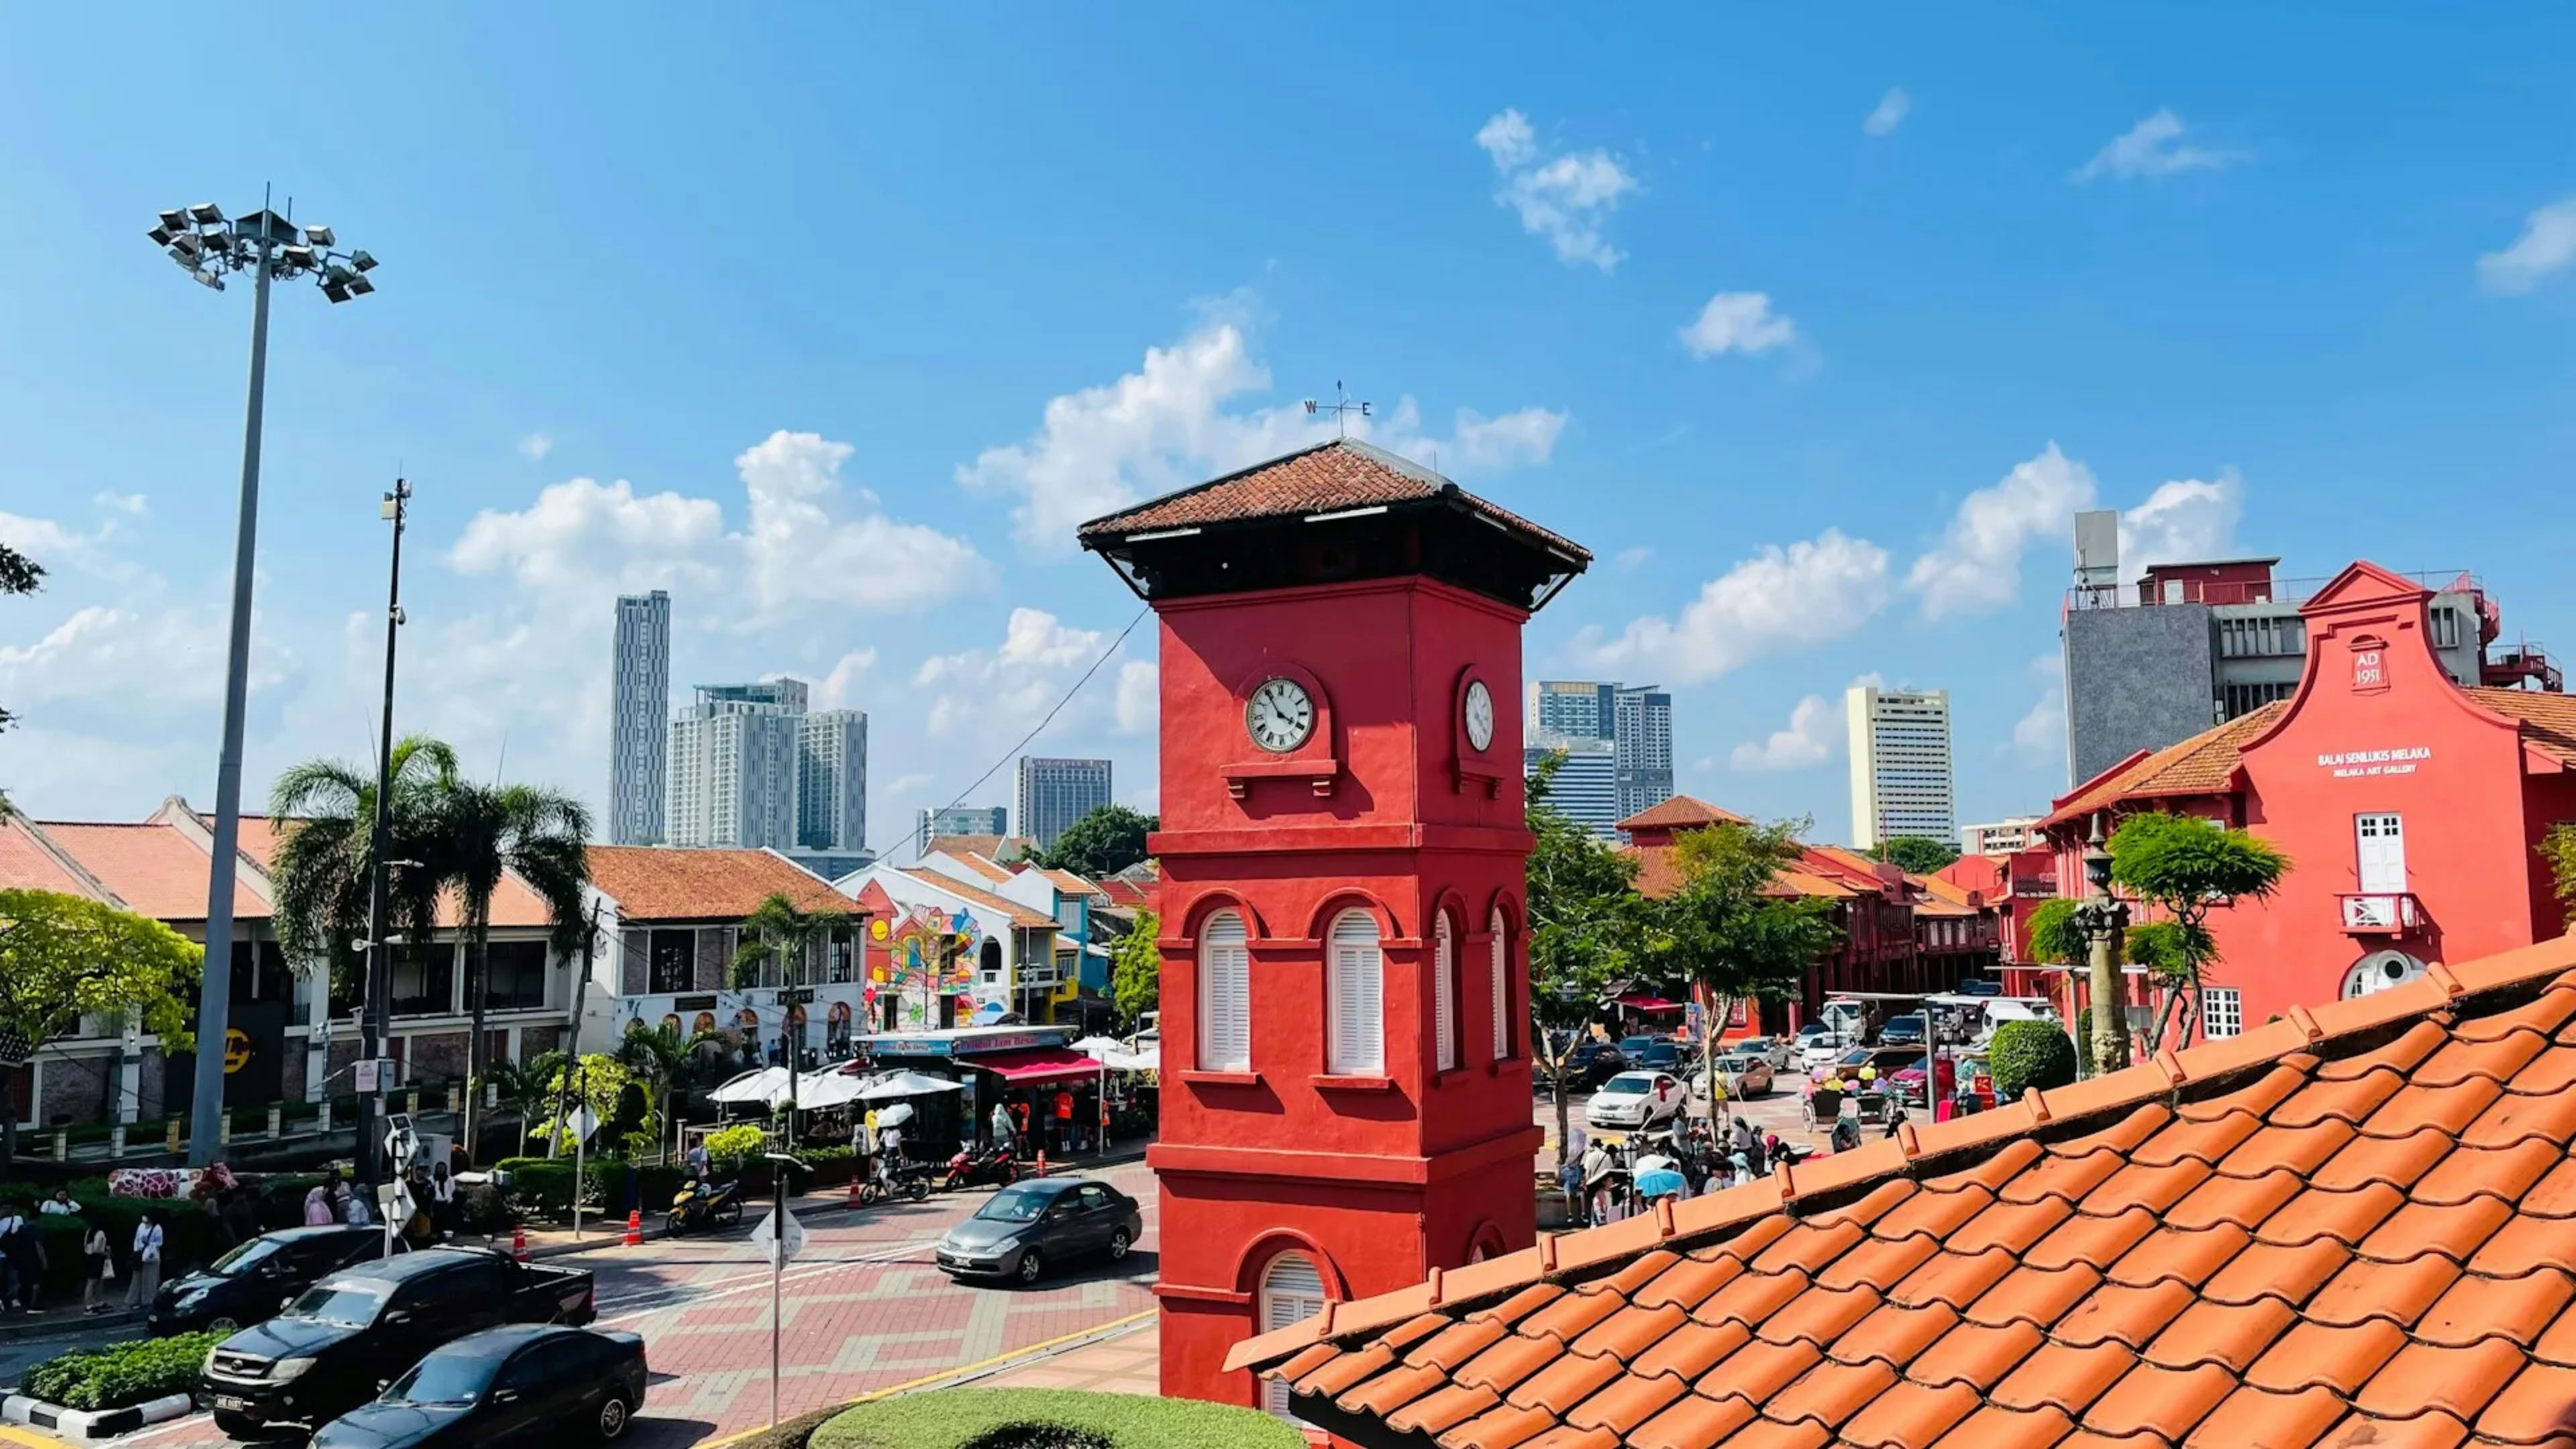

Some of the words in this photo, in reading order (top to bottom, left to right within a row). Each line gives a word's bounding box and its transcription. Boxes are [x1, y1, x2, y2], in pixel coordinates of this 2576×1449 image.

[1305, 400, 1317, 414] W
[1362, 402, 1371, 416] E
[2357, 653, 2379, 667] AD
[2318, 753, 2345, 766] BALAI
[2391, 747, 2431, 761] MELAKA
[2333, 768, 2365, 777] MELAKA
[2367, 767, 2382, 775] ART
[2383, 764, 2417, 775] GALLERY
